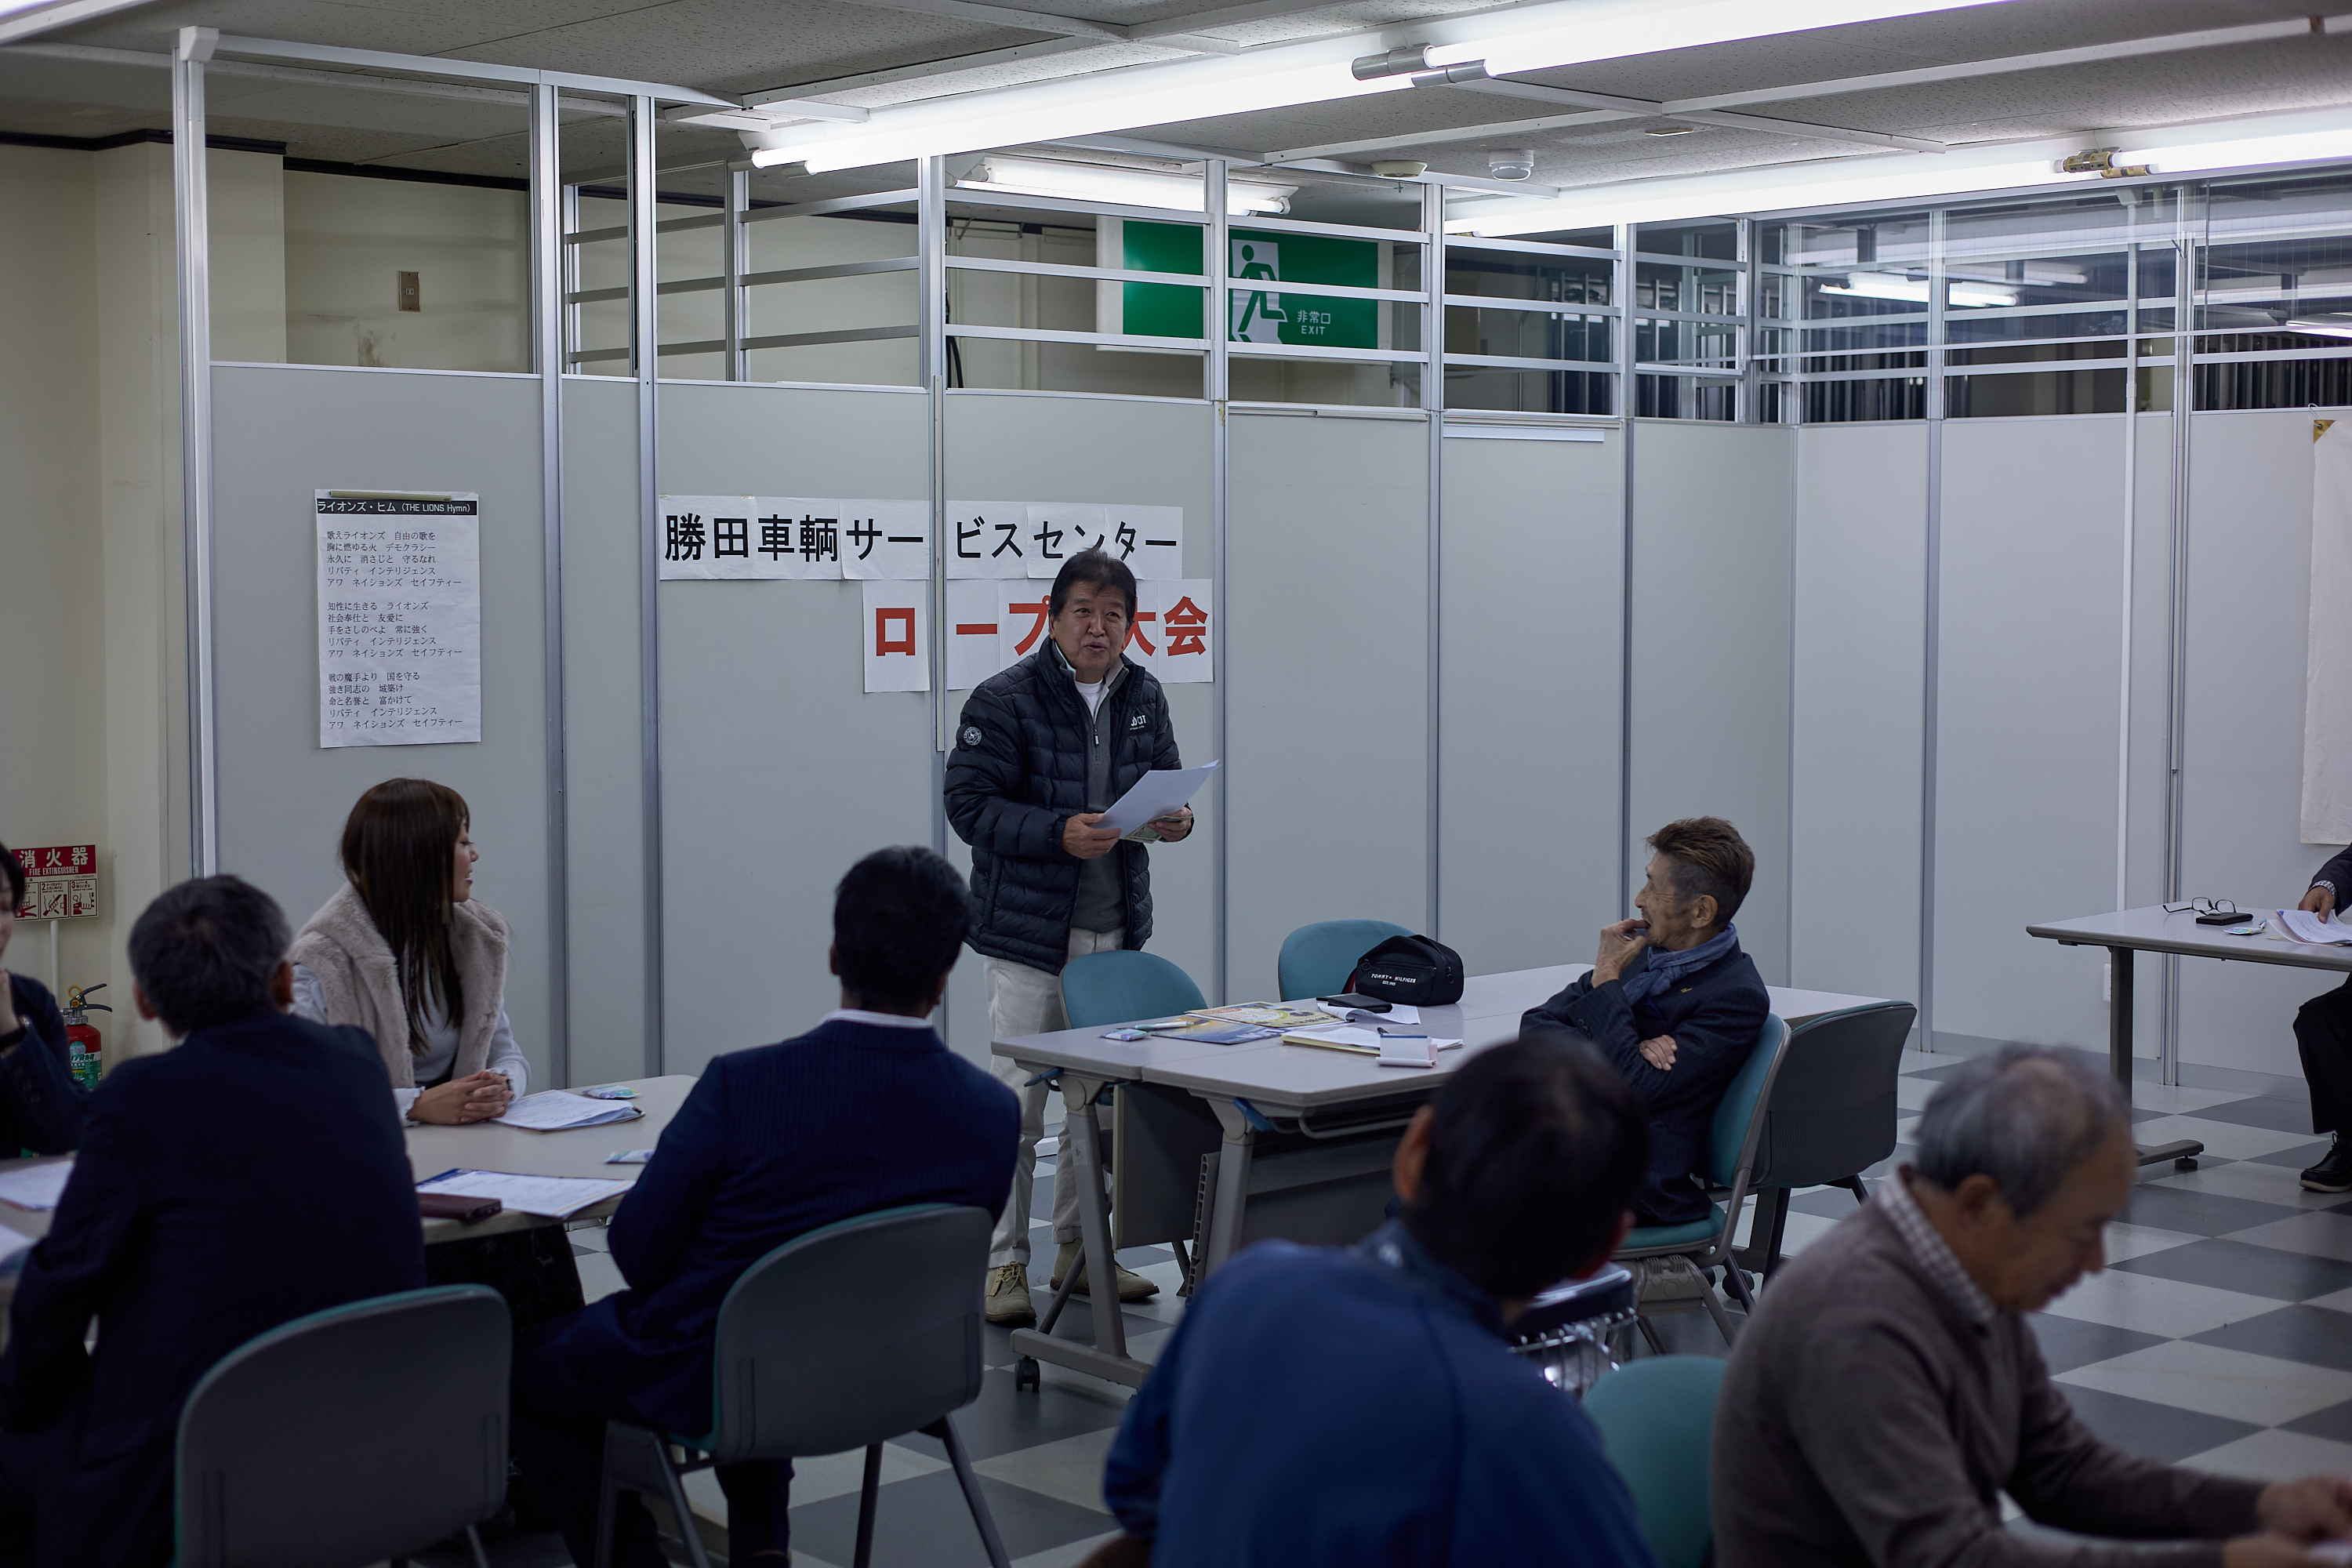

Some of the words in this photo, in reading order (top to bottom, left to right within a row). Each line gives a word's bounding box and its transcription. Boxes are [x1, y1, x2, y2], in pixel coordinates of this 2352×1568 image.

[1297, 310, 1330, 325] 非常口
[1301, 325, 1325, 335] EXIT
[318, 501, 396, 513] ライオンズ・ヒム
[327, 532, 385, 540] 歌えライオンズ
[394, 532, 435, 540] 自由の歌を
[327, 543, 376, 552] 胸に燃ゆる火
[361, 555, 394, 564] 消さじと
[402, 555, 436, 564] 守るなれ
[328, 602, 377, 611] 知性に生きる
[387, 601, 428, 610] ライオンズ
[328, 614, 368, 622] 社会奉仕と
[328, 626, 386, 634] 手をさしのべよ
[395, 625, 427, 633] 常に強く
[353, 648, 403, 658] ネイションズ
[412, 648, 462, 657] セイフティー
[328, 685, 369, 694] 強き同志の
[329, 697, 369, 706] 命と名誉と
[379, 696, 412, 705] 富かけて
[371, 708, 437, 717] インテリジェンス
[354, 720, 405, 728] ネイションズ
[19, 847, 88, 868] 消火器
[42, 866, 78, 875] EXTINGUISHER
